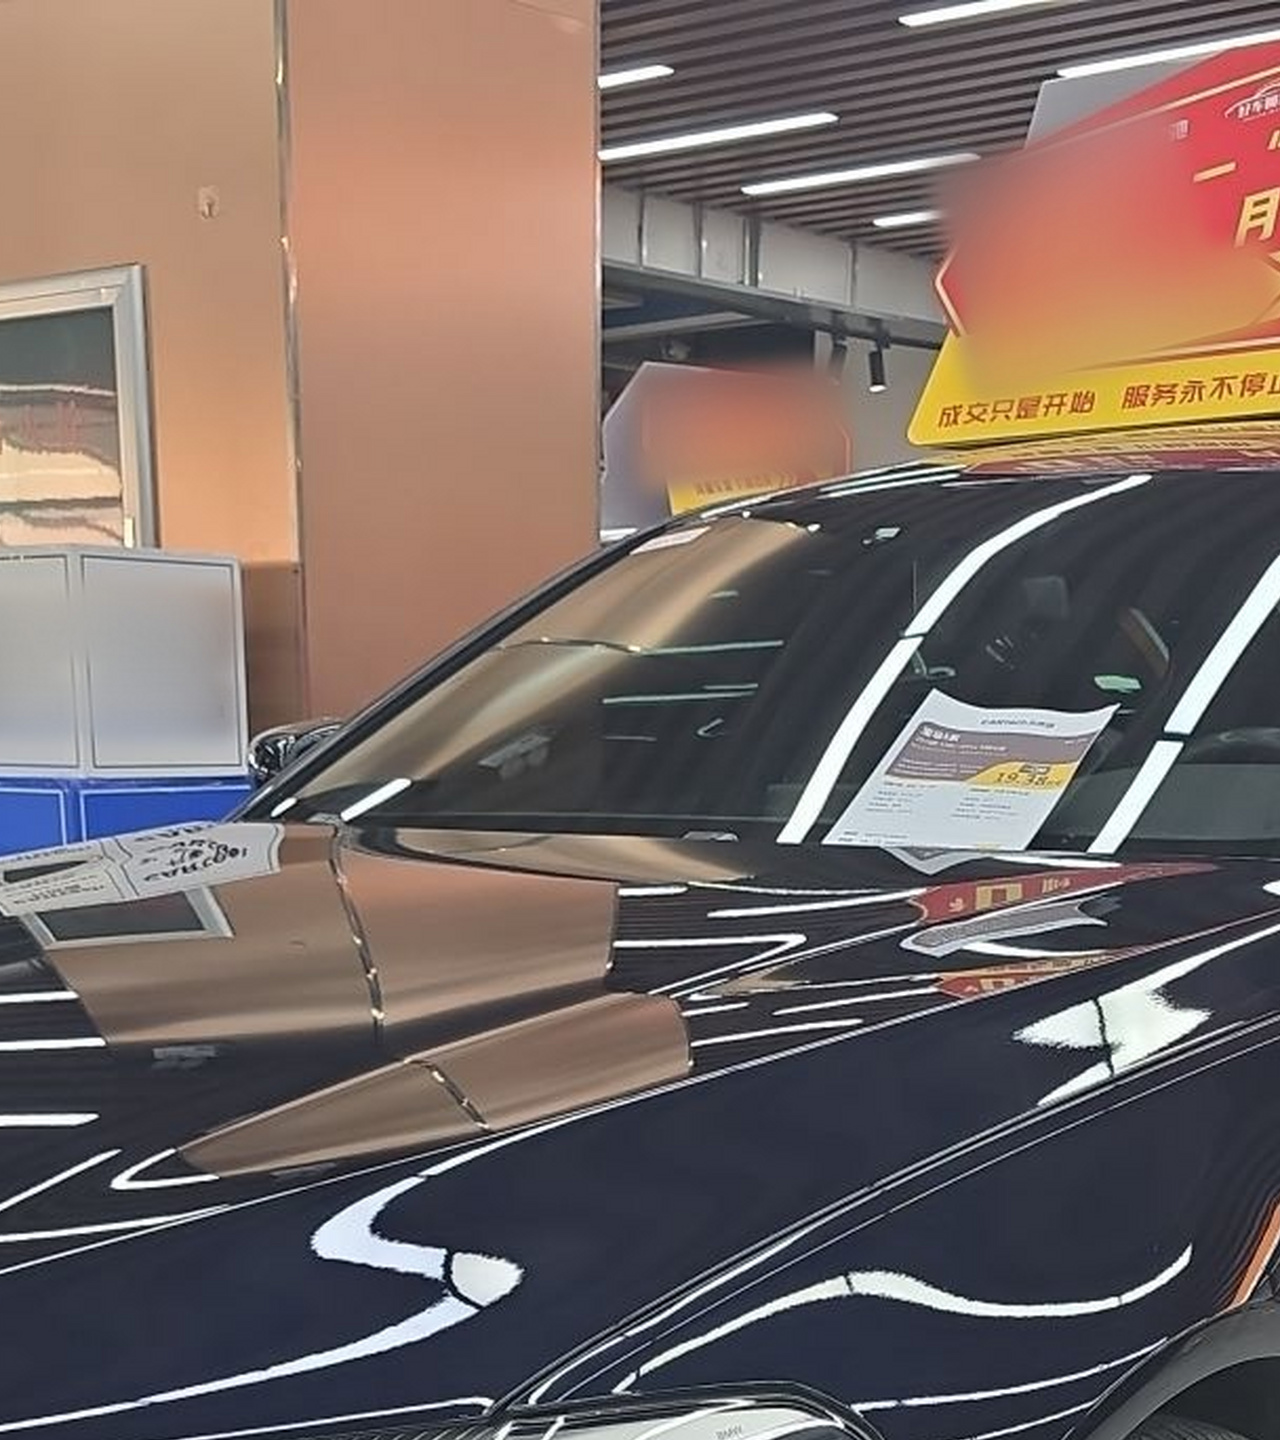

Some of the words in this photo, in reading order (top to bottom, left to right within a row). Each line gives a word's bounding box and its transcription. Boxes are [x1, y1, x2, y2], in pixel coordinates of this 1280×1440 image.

[937, 389, 1097, 429] 成交只是开始
